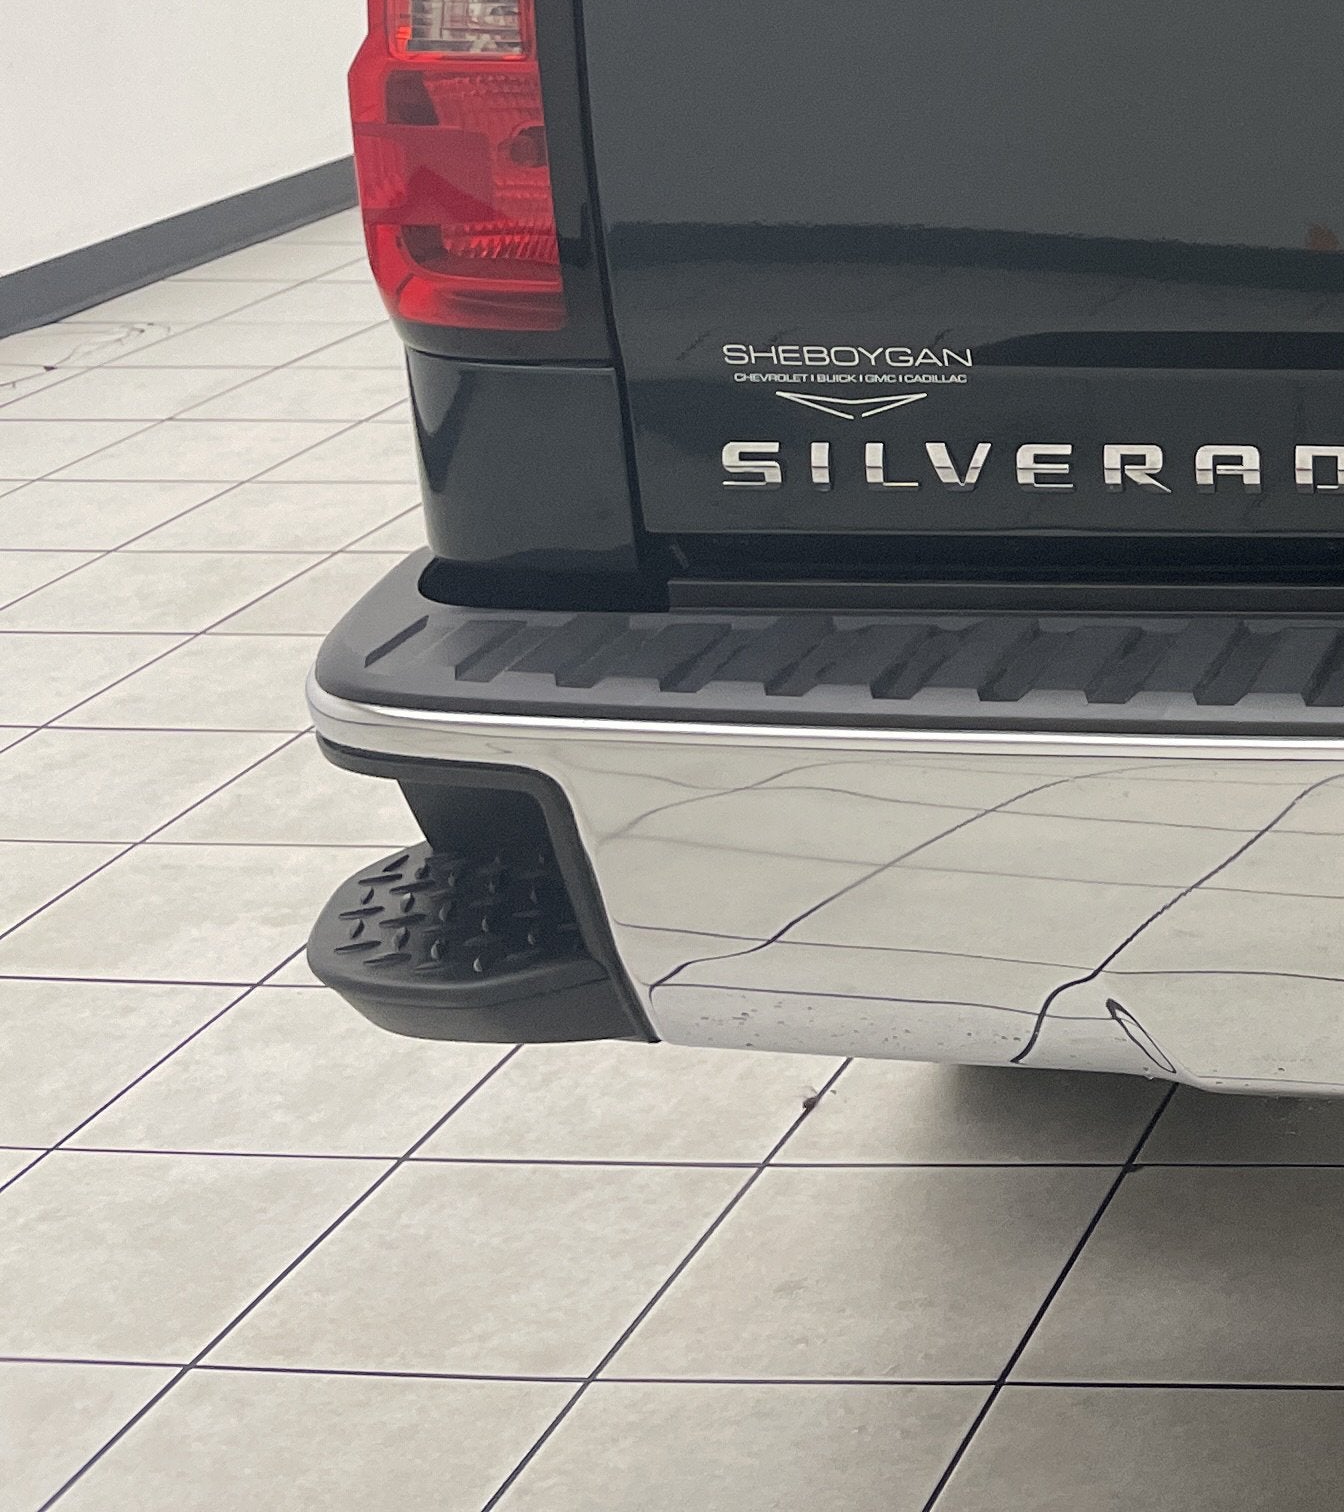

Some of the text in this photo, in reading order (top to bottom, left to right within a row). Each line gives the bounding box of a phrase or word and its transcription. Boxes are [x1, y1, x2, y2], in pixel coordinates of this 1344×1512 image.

[722, 343, 973, 368] SHEBOYGAN
[733, 372, 968, 385] CHEVROLET BUICK GMC CADILLAC
